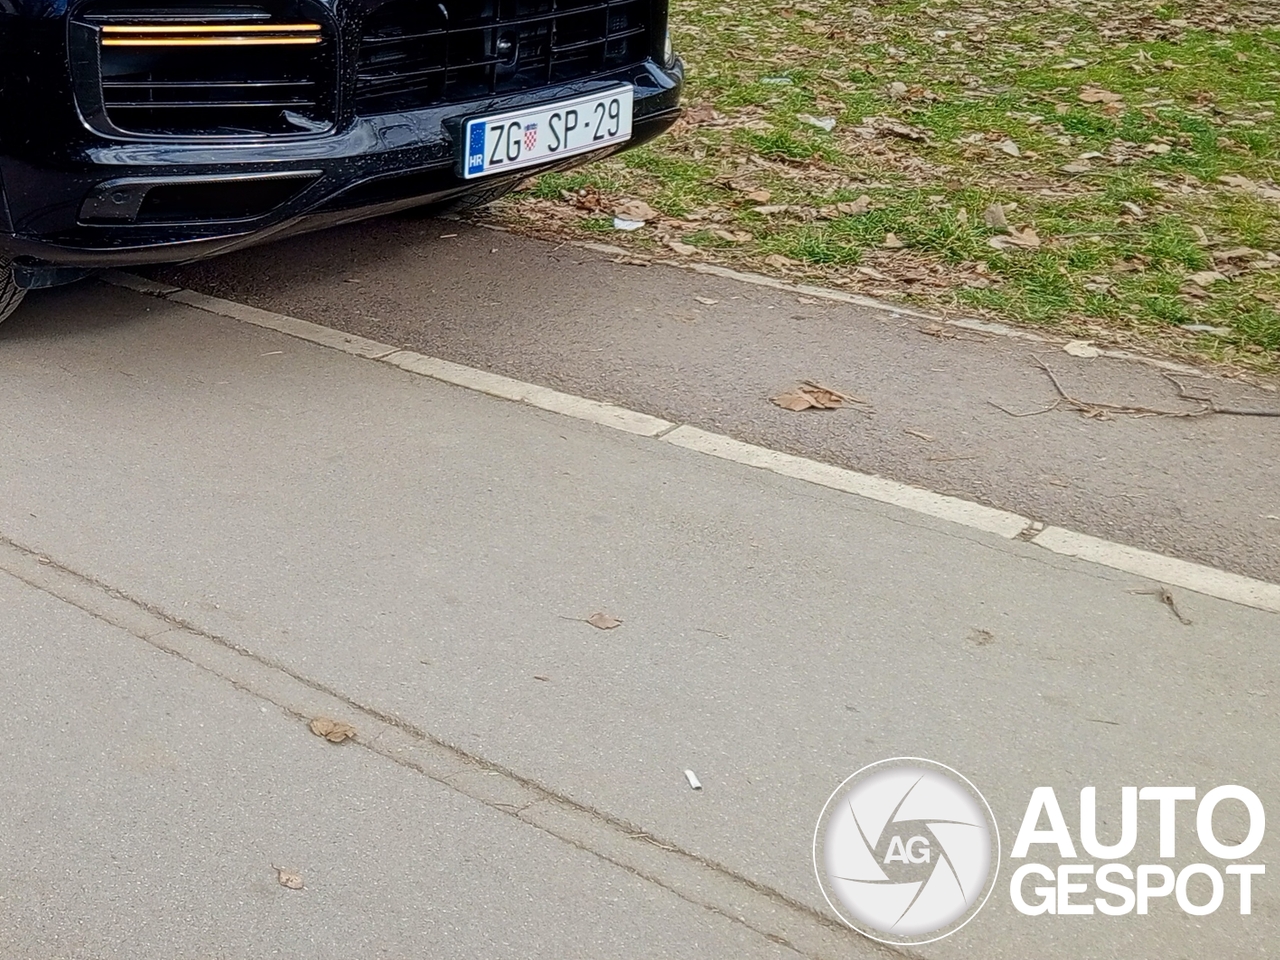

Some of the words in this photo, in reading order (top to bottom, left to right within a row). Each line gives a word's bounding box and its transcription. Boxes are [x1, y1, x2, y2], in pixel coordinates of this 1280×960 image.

[488, 121, 522, 165] ZG
[547, 98, 621, 152] SP-29
[470, 153, 483, 167] HR
